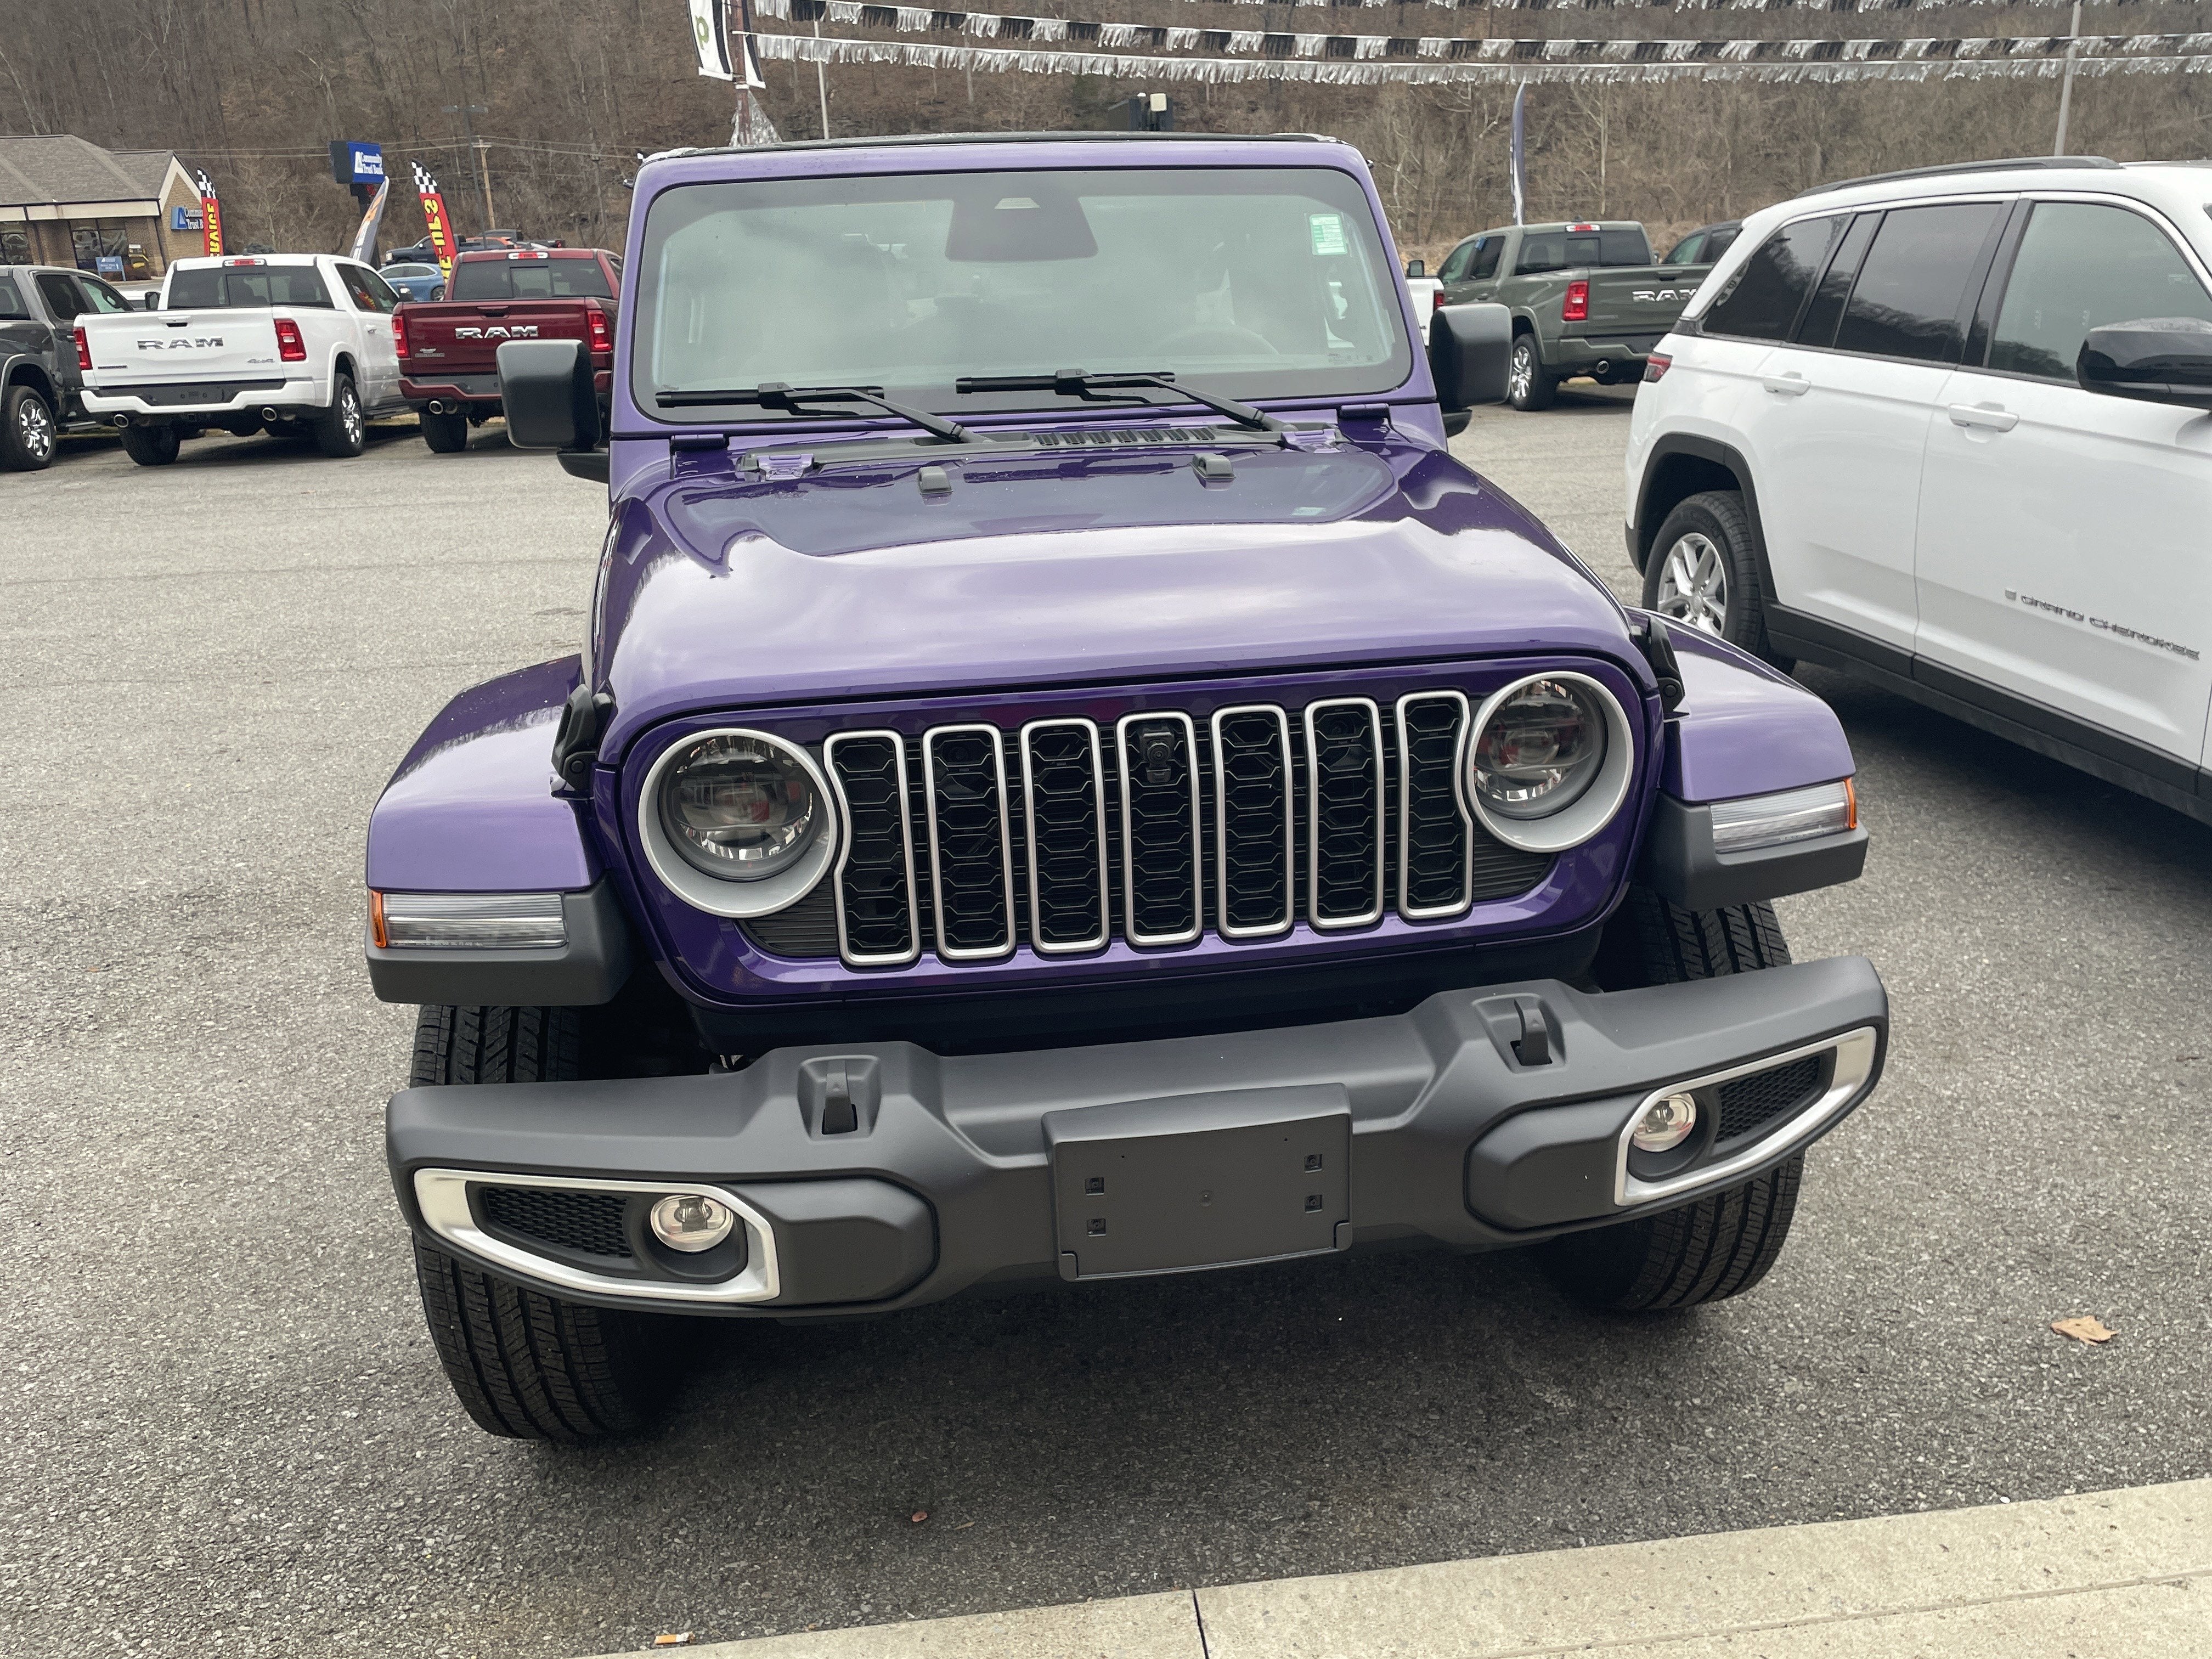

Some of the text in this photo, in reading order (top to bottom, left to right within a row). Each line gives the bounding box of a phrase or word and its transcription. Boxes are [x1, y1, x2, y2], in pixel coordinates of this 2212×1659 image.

[455, 325, 539, 339] RAM
[137, 336, 224, 350] RAM
[2021, 595, 2200, 661] GRAND CHEROKEE
